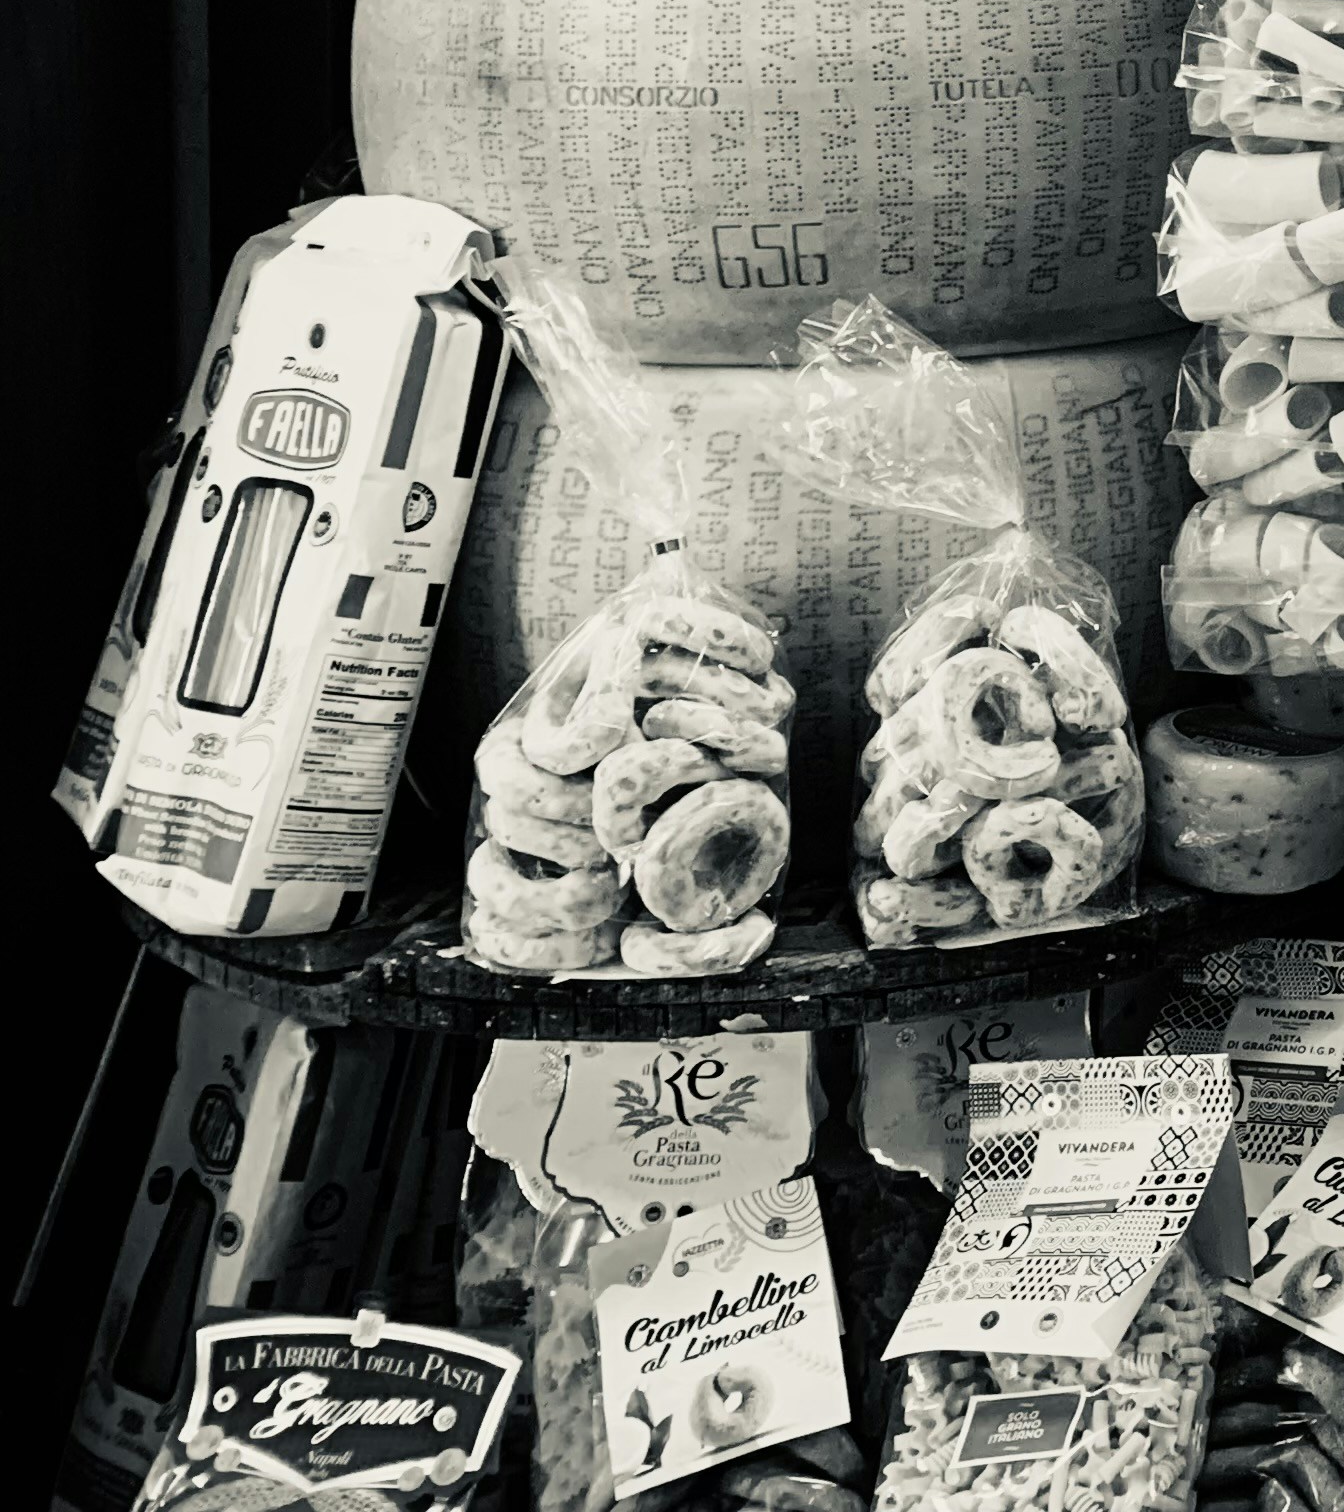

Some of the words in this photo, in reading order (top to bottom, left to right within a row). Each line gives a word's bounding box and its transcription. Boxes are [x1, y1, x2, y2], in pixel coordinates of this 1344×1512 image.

[566, 85, 719, 108] CONSORZIO
[930, 76, 1034, 102] TUTELA
[712, 222, 829, 289] 656
[280, 355, 341, 386] Pastificio
[247, 399, 343, 459] FAELLA
[329, 658, 383, 678] Nutrition
[1254, 1006, 1336, 1021] VIVANDERA
[1226, 1039, 1241, 1051] DI
[1241, 1040, 1307, 1055] GRAGNANO
[1268, 1033, 1303, 1045] PASTA
[656, 1136, 702, 1154] Pasta
[1057, 1141, 1136, 1155] VIVANDERA
[632, 1148, 722, 1173] Gragnano
[1302, 1193, 1339, 1215] al
[623, 1271, 820, 1353] Ciambelline
[640, 1342, 672, 1375] al
[679, 1300, 808, 1364] Limocello
[224, 1355, 246, 1372] LA
[252, 1341, 360, 1370] FABBRICA
[364, 1354, 415, 1378] DELLA
[418, 1352, 485, 1396] PASTA
[996, 1418, 1043, 1435] GRANO
[1006, 1409, 1041, 1424] SOLO
[986, 1428, 1046, 1446] ITALIANO
[306, 1449, 355, 1467] Napoli
